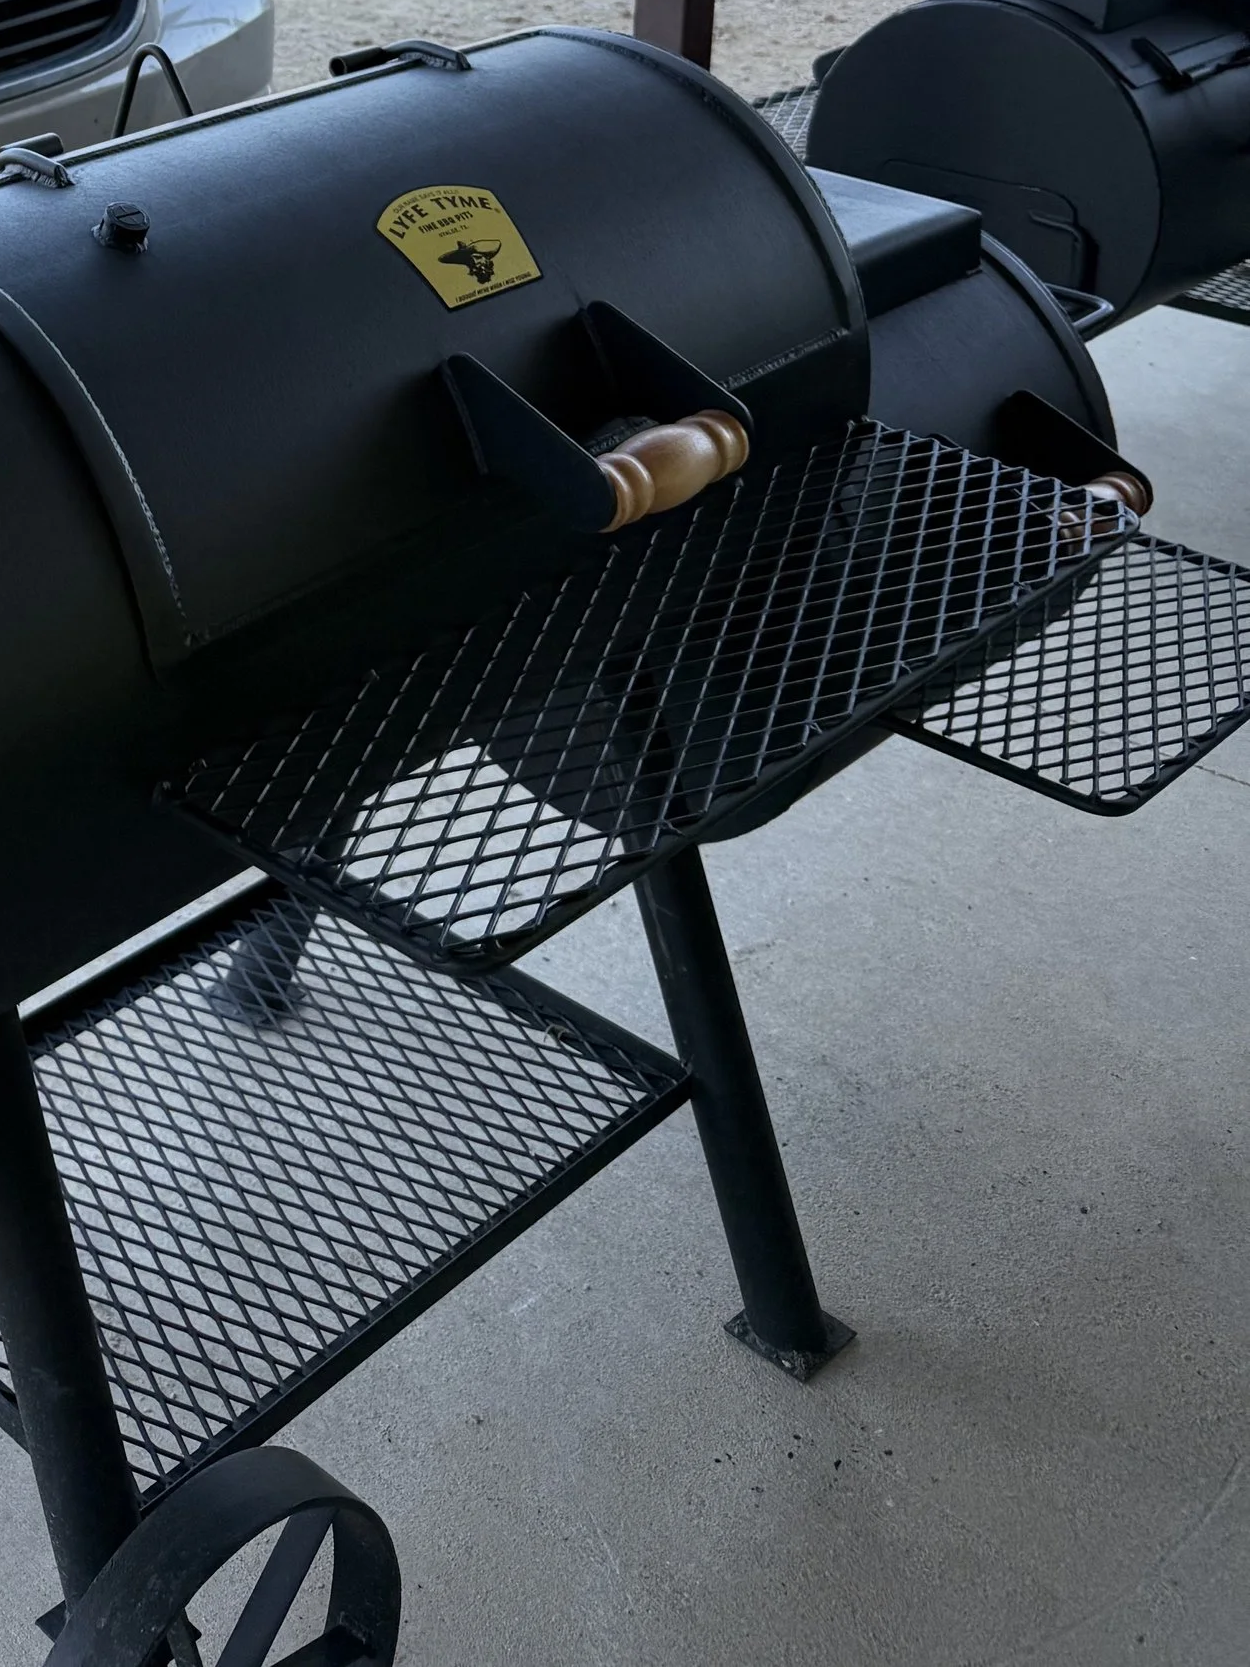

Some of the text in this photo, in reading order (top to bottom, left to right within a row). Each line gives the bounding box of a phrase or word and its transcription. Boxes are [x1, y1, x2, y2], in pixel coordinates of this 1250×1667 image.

[389, 196, 492, 239] LYFE TYME
[418, 211, 473, 234] FINE BBQ PITS
